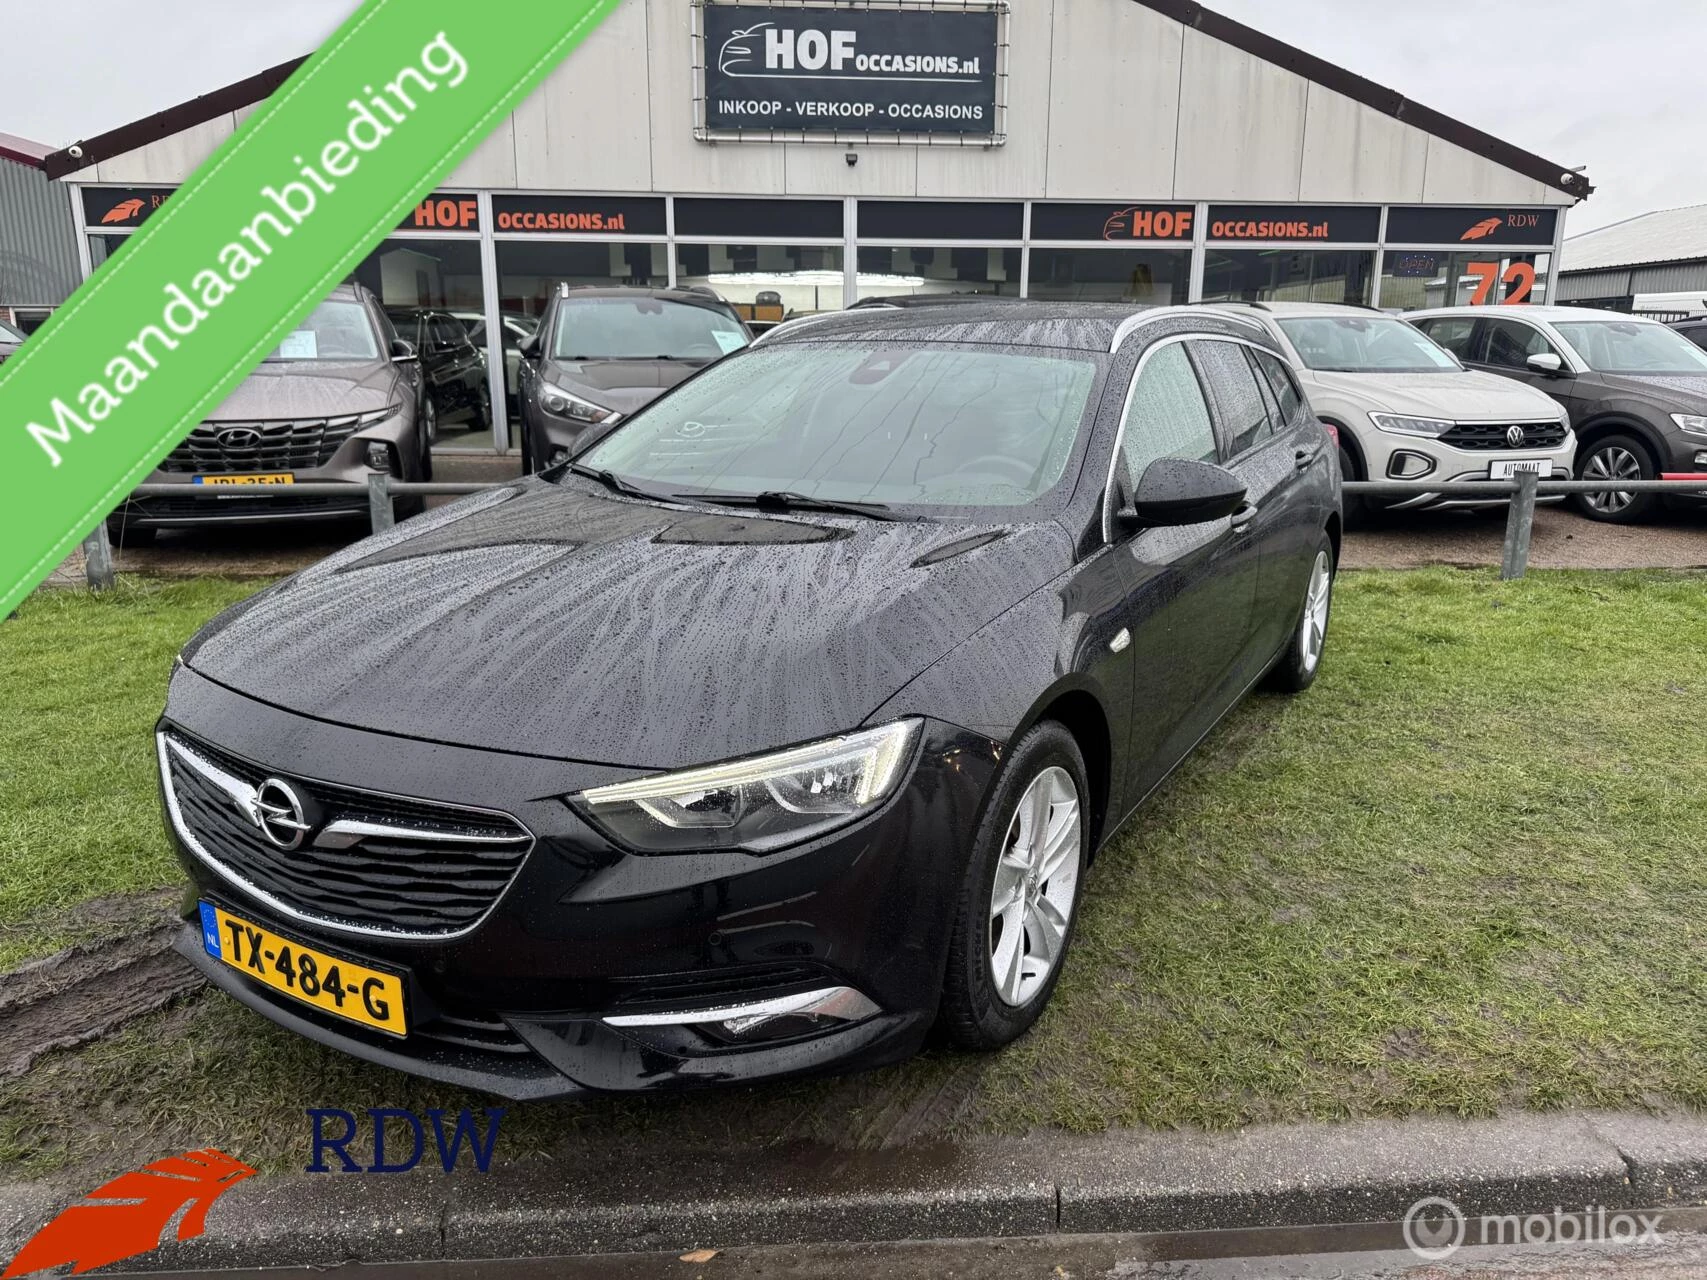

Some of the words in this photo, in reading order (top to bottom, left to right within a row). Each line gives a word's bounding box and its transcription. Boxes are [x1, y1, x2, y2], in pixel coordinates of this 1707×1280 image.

[765, 29, 856, 70] HOF
[855, 55, 980, 74] OCCASIONS.nl
[719, 101, 782, 114] INKOOP
[795, 102, 874, 117] VERKOOP
[888, 104, 983, 119] OCCASIONS
[415, 200, 476, 227] HOF
[498, 212, 625, 230] OCCASIONS.nl
[1133, 211, 1192, 237] HOF
[1507, 214, 1540, 227] RDW
[1212, 221, 1328, 238] OCCASIONS.nl
[1466, 262, 1536, 305] 72
[207, 932, 219, 948] NL
[225, 919, 390, 1021] TX-484-G
